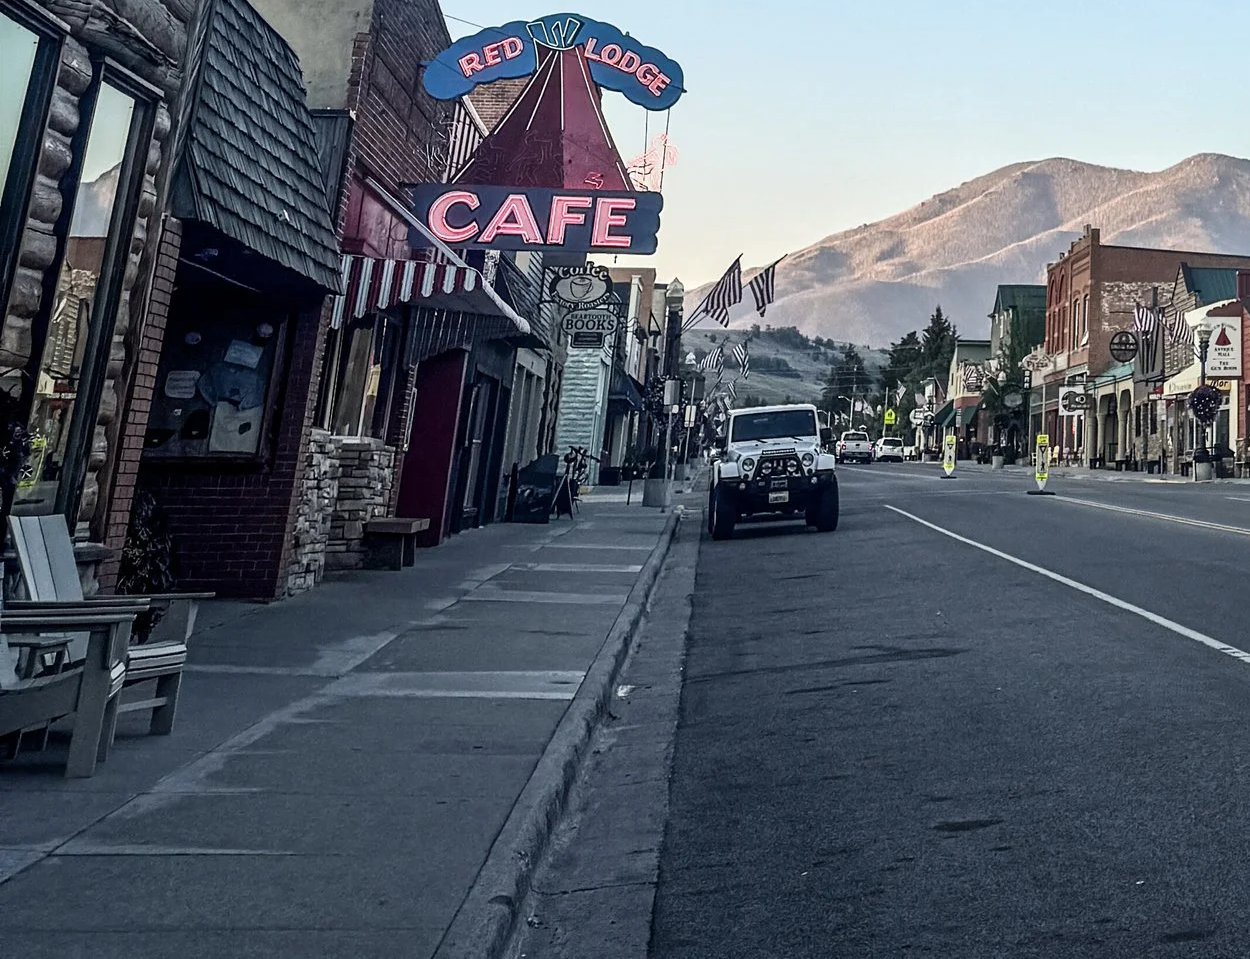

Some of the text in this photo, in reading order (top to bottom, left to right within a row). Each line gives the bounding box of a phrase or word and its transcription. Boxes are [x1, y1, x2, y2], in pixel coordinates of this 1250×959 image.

[458, 36, 672, 97] RED LODGE
[428, 190, 636, 247] CAFE
[558, 261, 608, 281] Coffee
[565, 319, 615, 331] BOOKS
